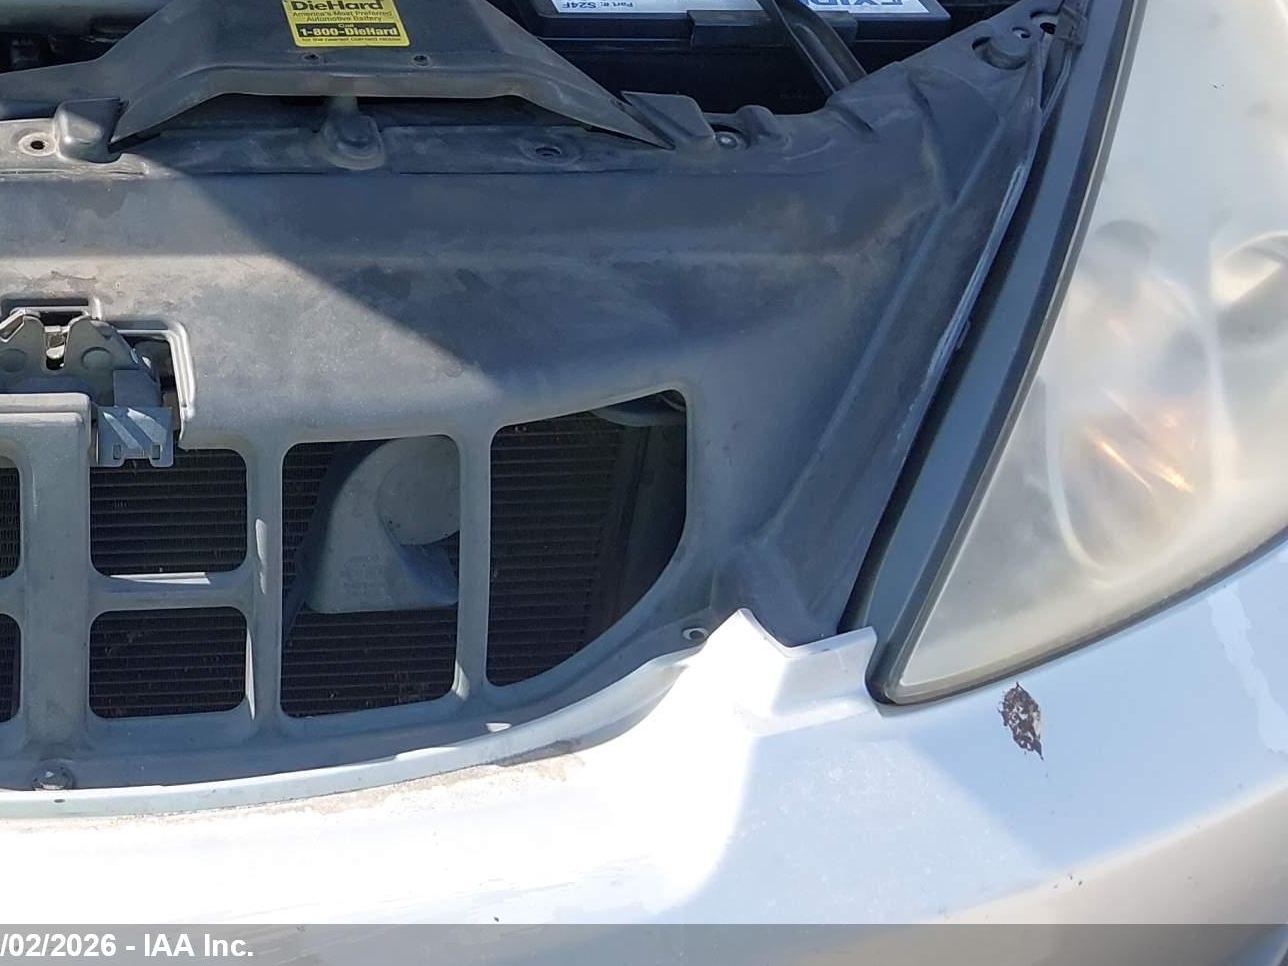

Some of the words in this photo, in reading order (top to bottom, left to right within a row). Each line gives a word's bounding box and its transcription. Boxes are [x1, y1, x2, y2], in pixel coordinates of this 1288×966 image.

[290, 0, 384, 11] DieHard
[562, 1, 597, 9] S24F
[299, 27, 399, 37] 1-800-DieHard
